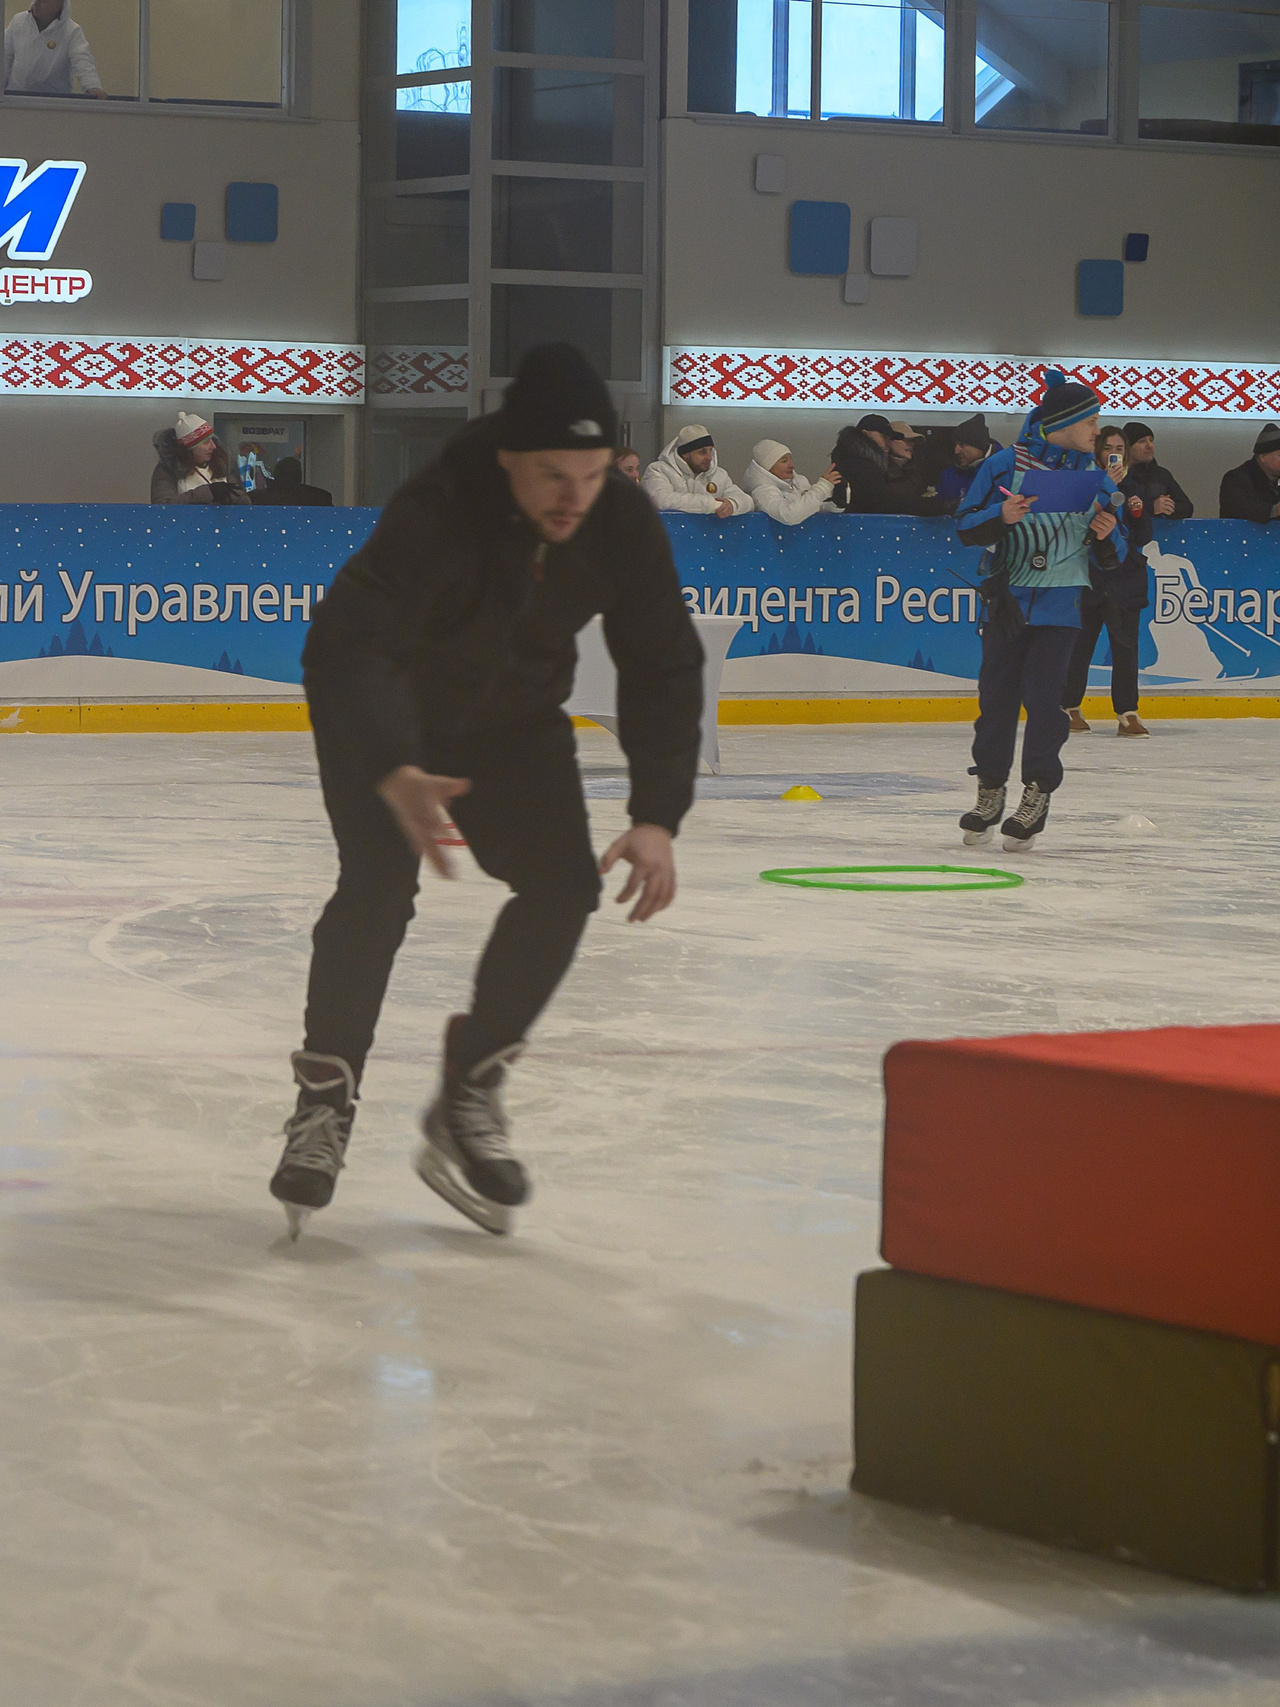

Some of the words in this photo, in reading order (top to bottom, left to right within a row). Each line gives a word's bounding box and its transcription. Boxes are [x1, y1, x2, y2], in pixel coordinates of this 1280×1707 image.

[242, 426, 286, 435] ВОЗВРАТ
[60, 569, 325, 637] Управлен
[682, 583, 861, 632] зидента
[875, 575, 980, 624] Респ
